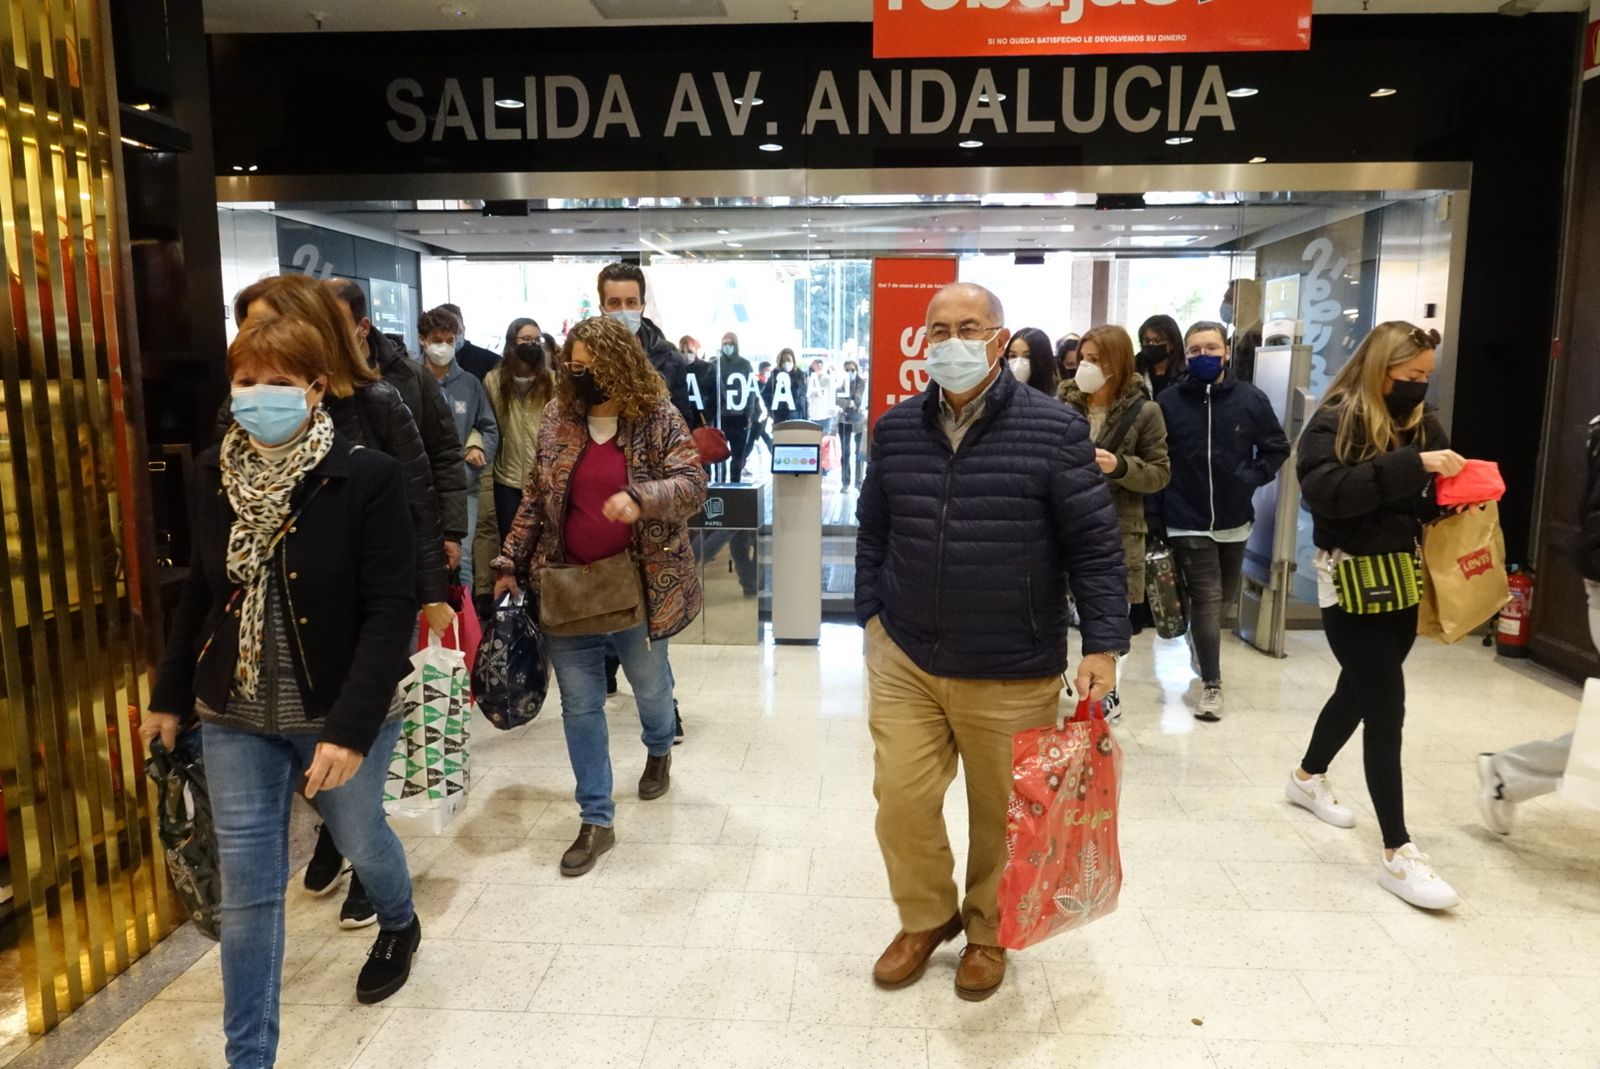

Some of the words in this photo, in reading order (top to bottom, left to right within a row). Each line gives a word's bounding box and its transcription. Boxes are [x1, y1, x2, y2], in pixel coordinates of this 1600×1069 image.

[996, 37, 1008, 45] NO
[1009, 37, 1035, 45] QUEDA
[1036, 36, 1082, 44] SATISFECHO
[1094, 35, 1145, 43] DEVOLVEMOS
[1146, 34, 1157, 42] SU
[1158, 34, 1187, 42] DINERO
[385, 73, 641, 143] SALIDA
[663, 71, 778, 138] AV.
[801, 64, 1237, 136] ANDALUCIA
